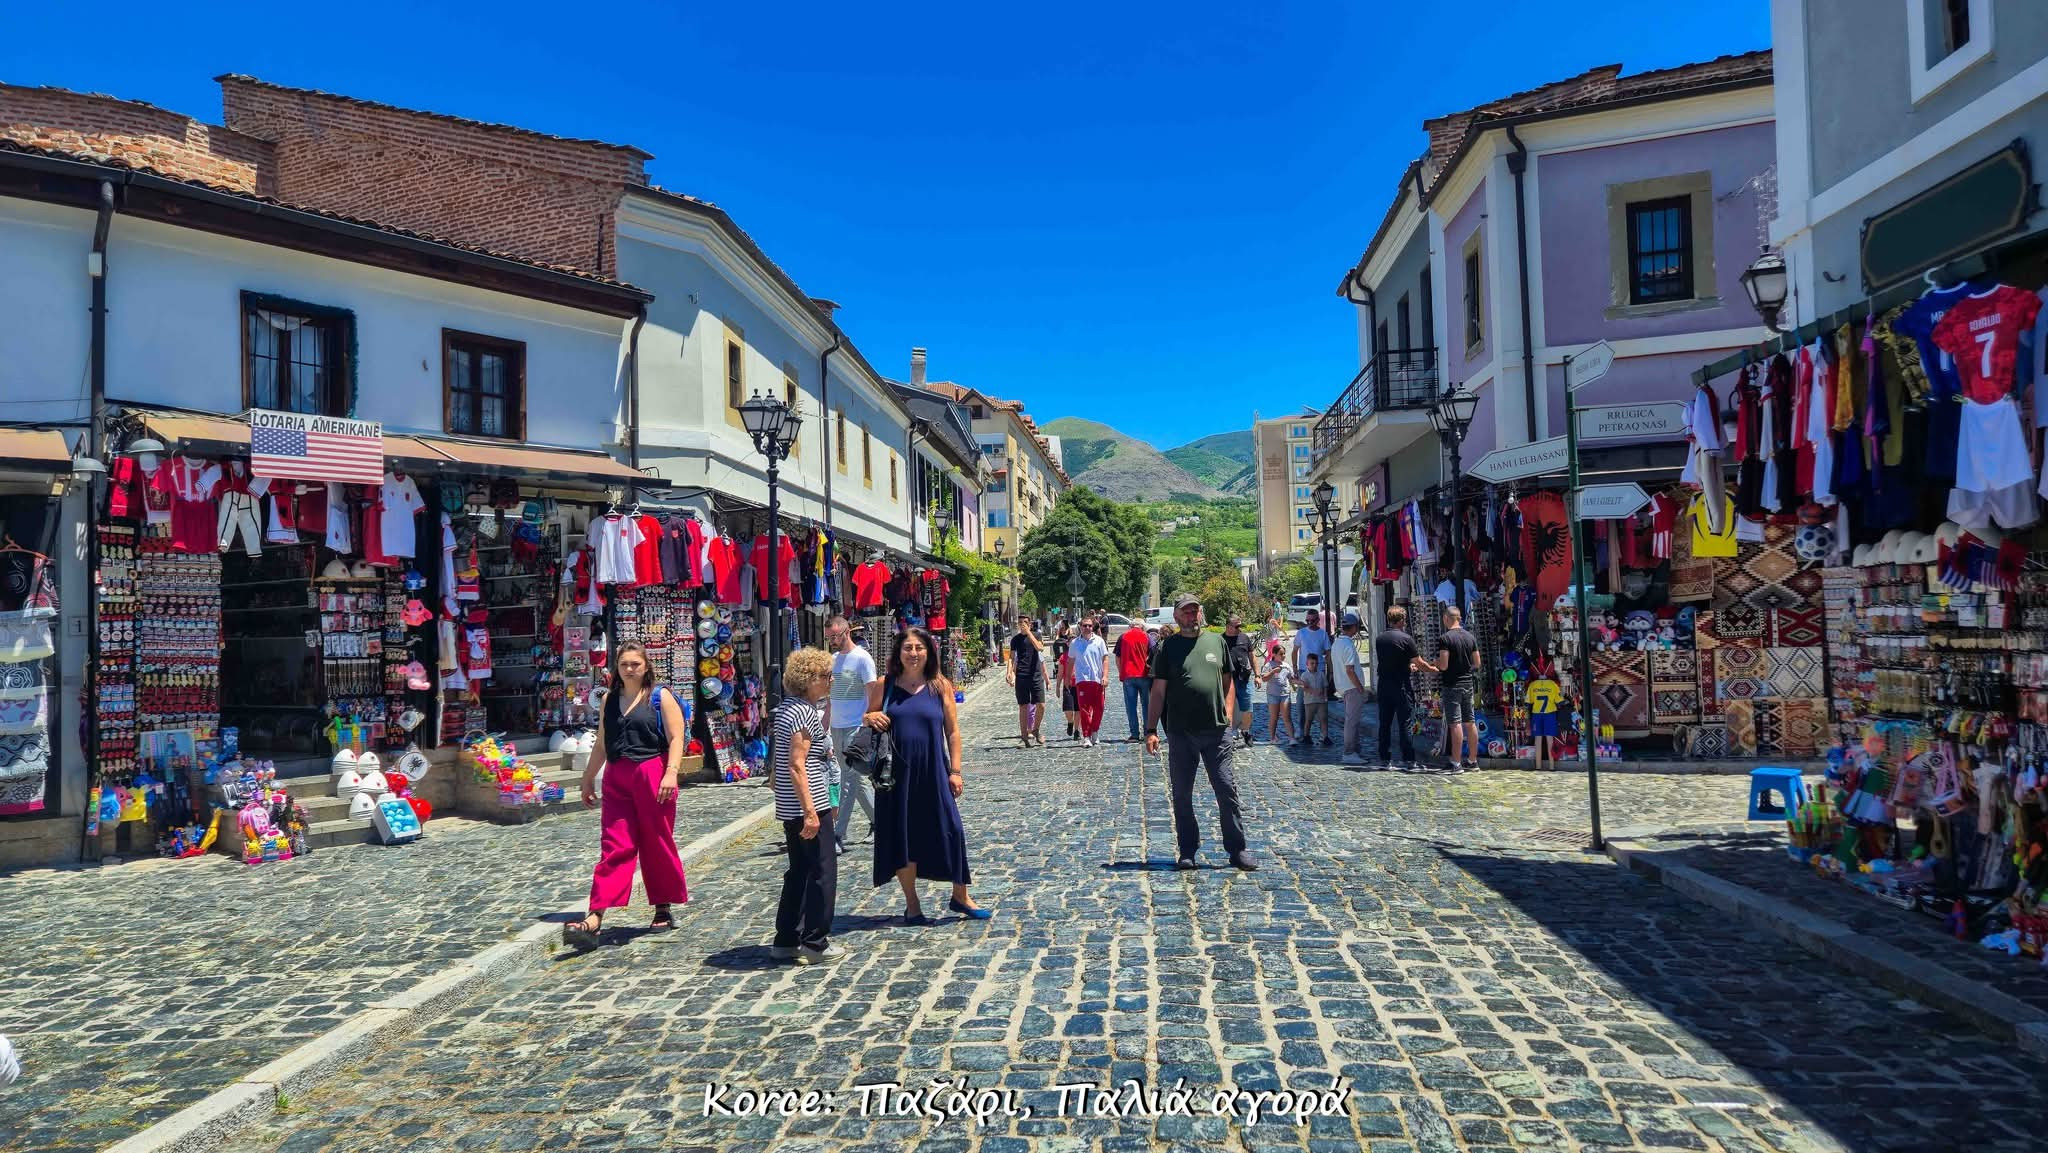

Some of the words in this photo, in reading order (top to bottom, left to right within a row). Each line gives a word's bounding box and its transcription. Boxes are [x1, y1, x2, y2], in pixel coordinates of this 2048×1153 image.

[1975, 331, 1995, 378] 7
[252, 412, 306, 431] LOTARIA
[1607, 409, 1655, 420] RRUGICA
[1598, 422, 1640, 432] PETRAQ
[1642, 420, 1667, 429] NASI
[1489, 460, 1512, 472] HANI
[1536, 695, 1549, 712] 7
